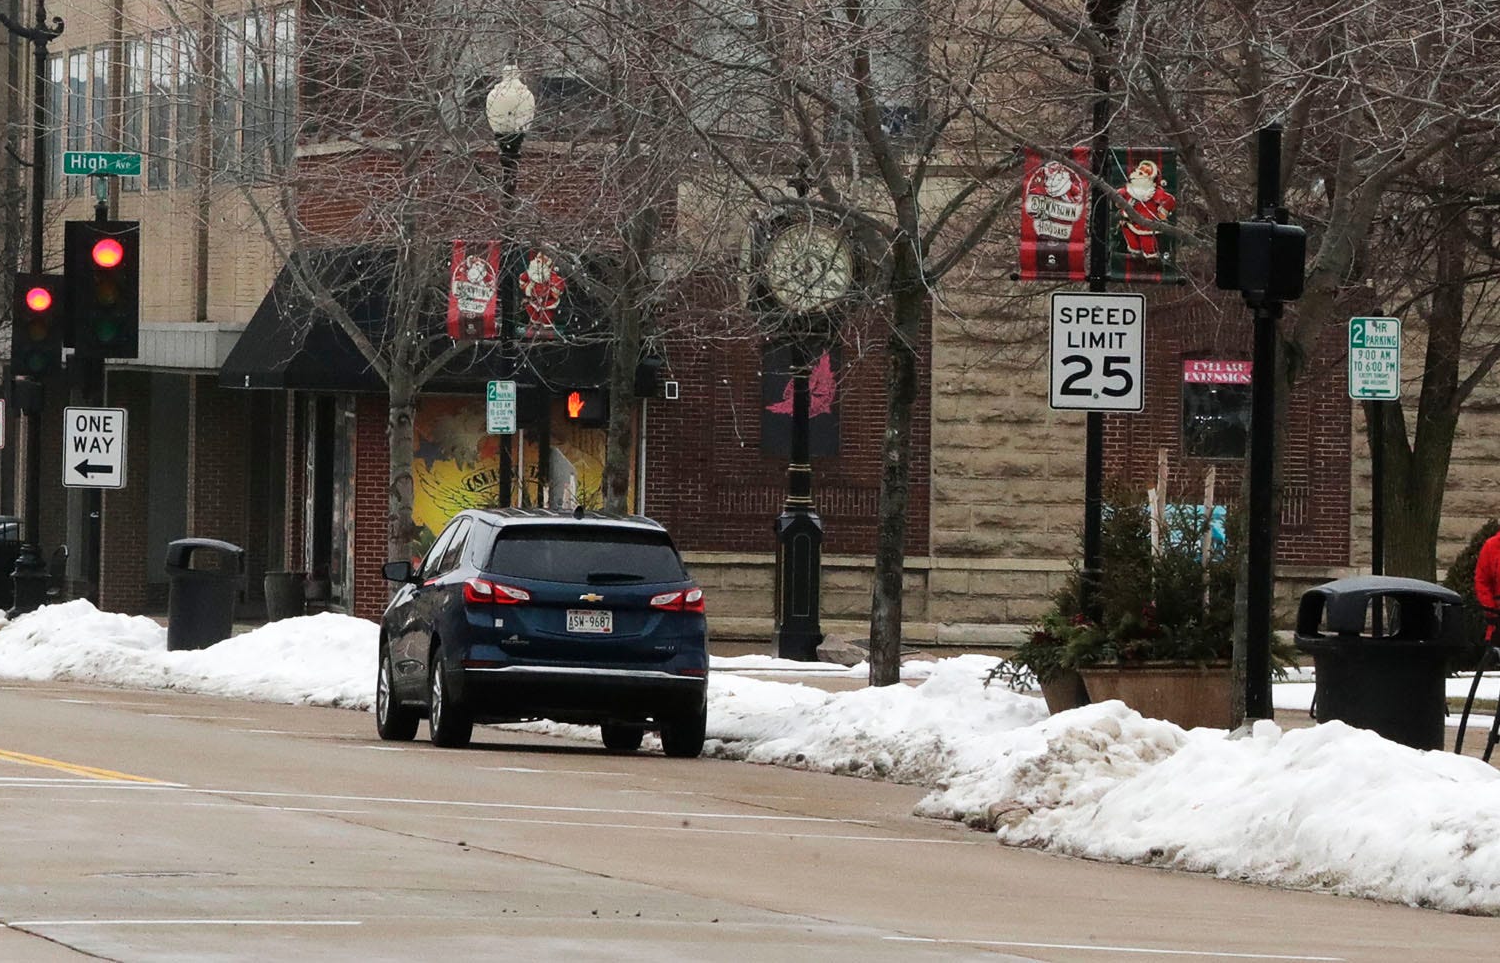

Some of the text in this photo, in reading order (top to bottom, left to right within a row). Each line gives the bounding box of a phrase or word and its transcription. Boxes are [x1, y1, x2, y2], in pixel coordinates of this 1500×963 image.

[71, 154, 131, 172] High Ave
[1060, 307, 1136, 325] SPEED
[1068, 331, 1127, 349] LIMIT
[1352, 323, 1388, 344] 2 HR
[1366, 335, 1397, 346] PARKING
[1381, 350, 1391, 360] AM
[1354, 361, 1395, 372] TO 6:00 PM
[1060, 355, 1133, 397] 25
[76, 415, 113, 432] ONE
[73, 436, 114, 454] WAY
